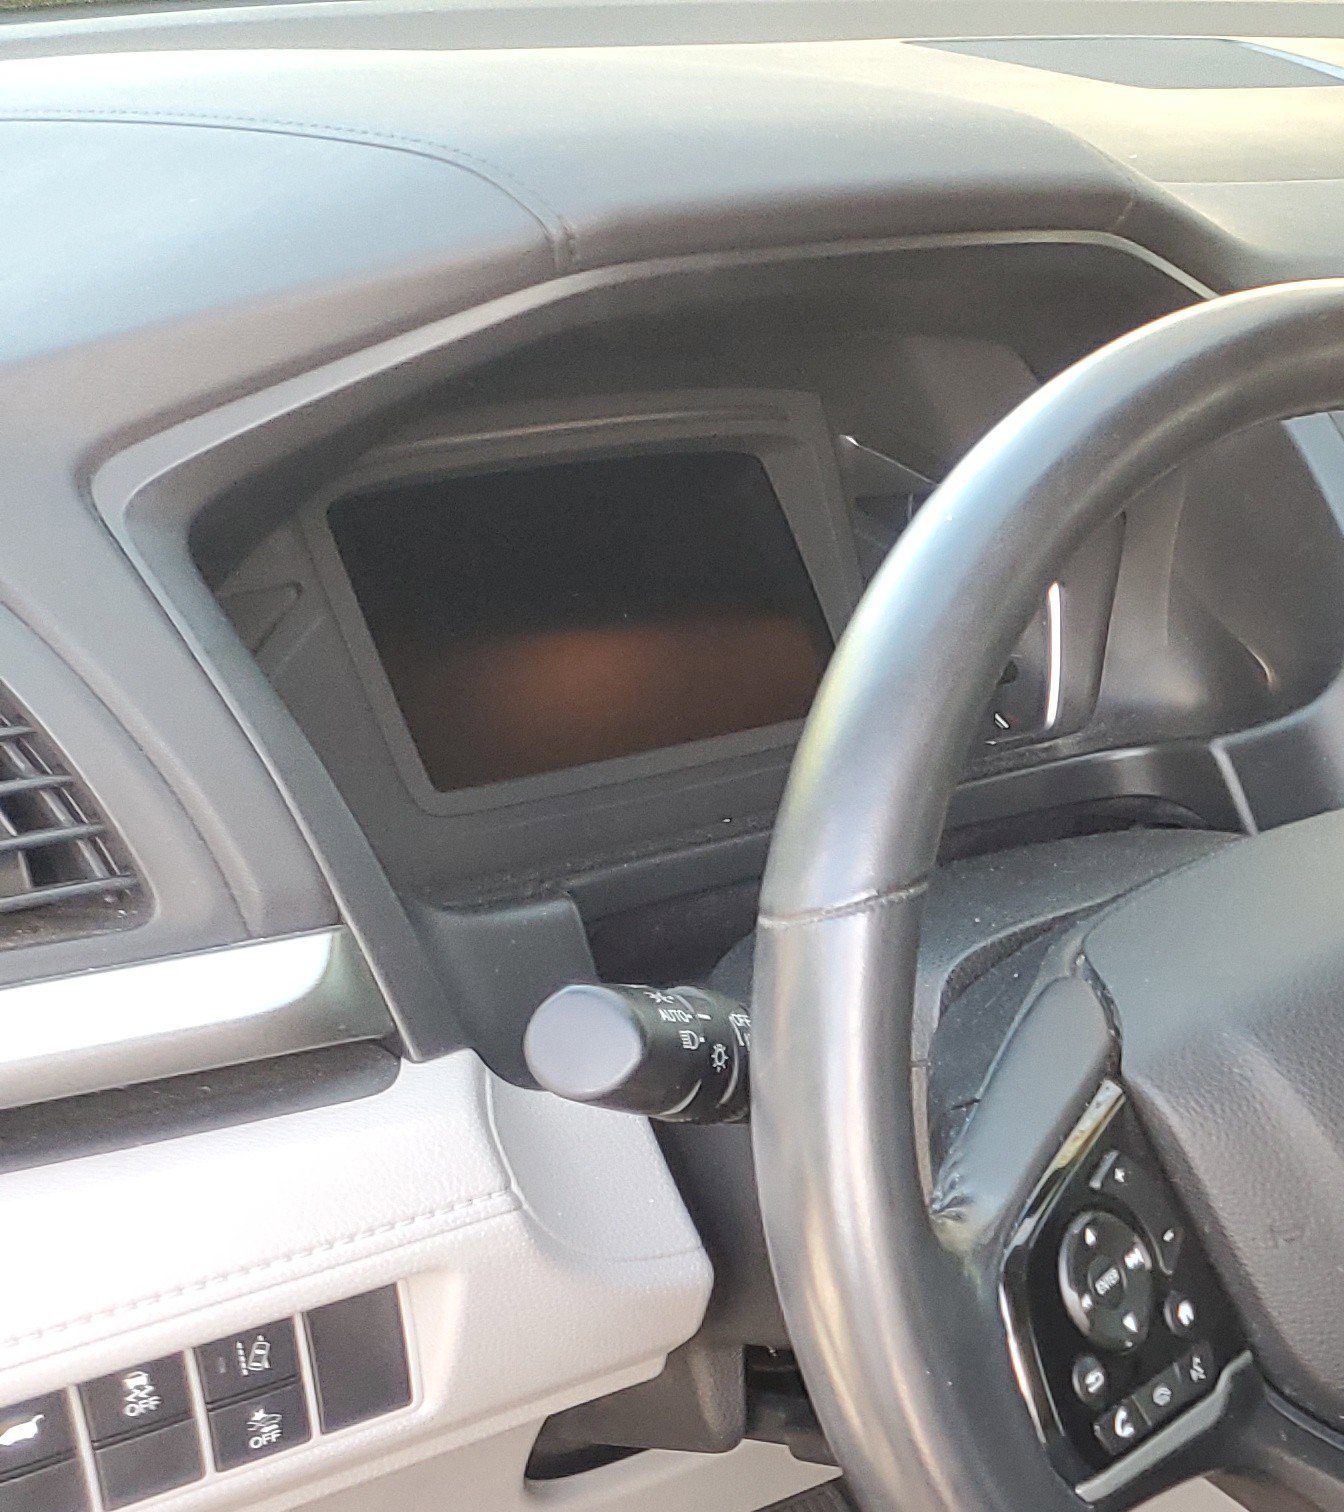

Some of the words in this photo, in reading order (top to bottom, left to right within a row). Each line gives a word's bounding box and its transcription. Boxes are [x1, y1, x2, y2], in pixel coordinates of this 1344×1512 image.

[658, 1009, 689, 1023] AUTO
[124, 1396, 161, 1417] OFF
[249, 1429, 282, 1449] OFF
